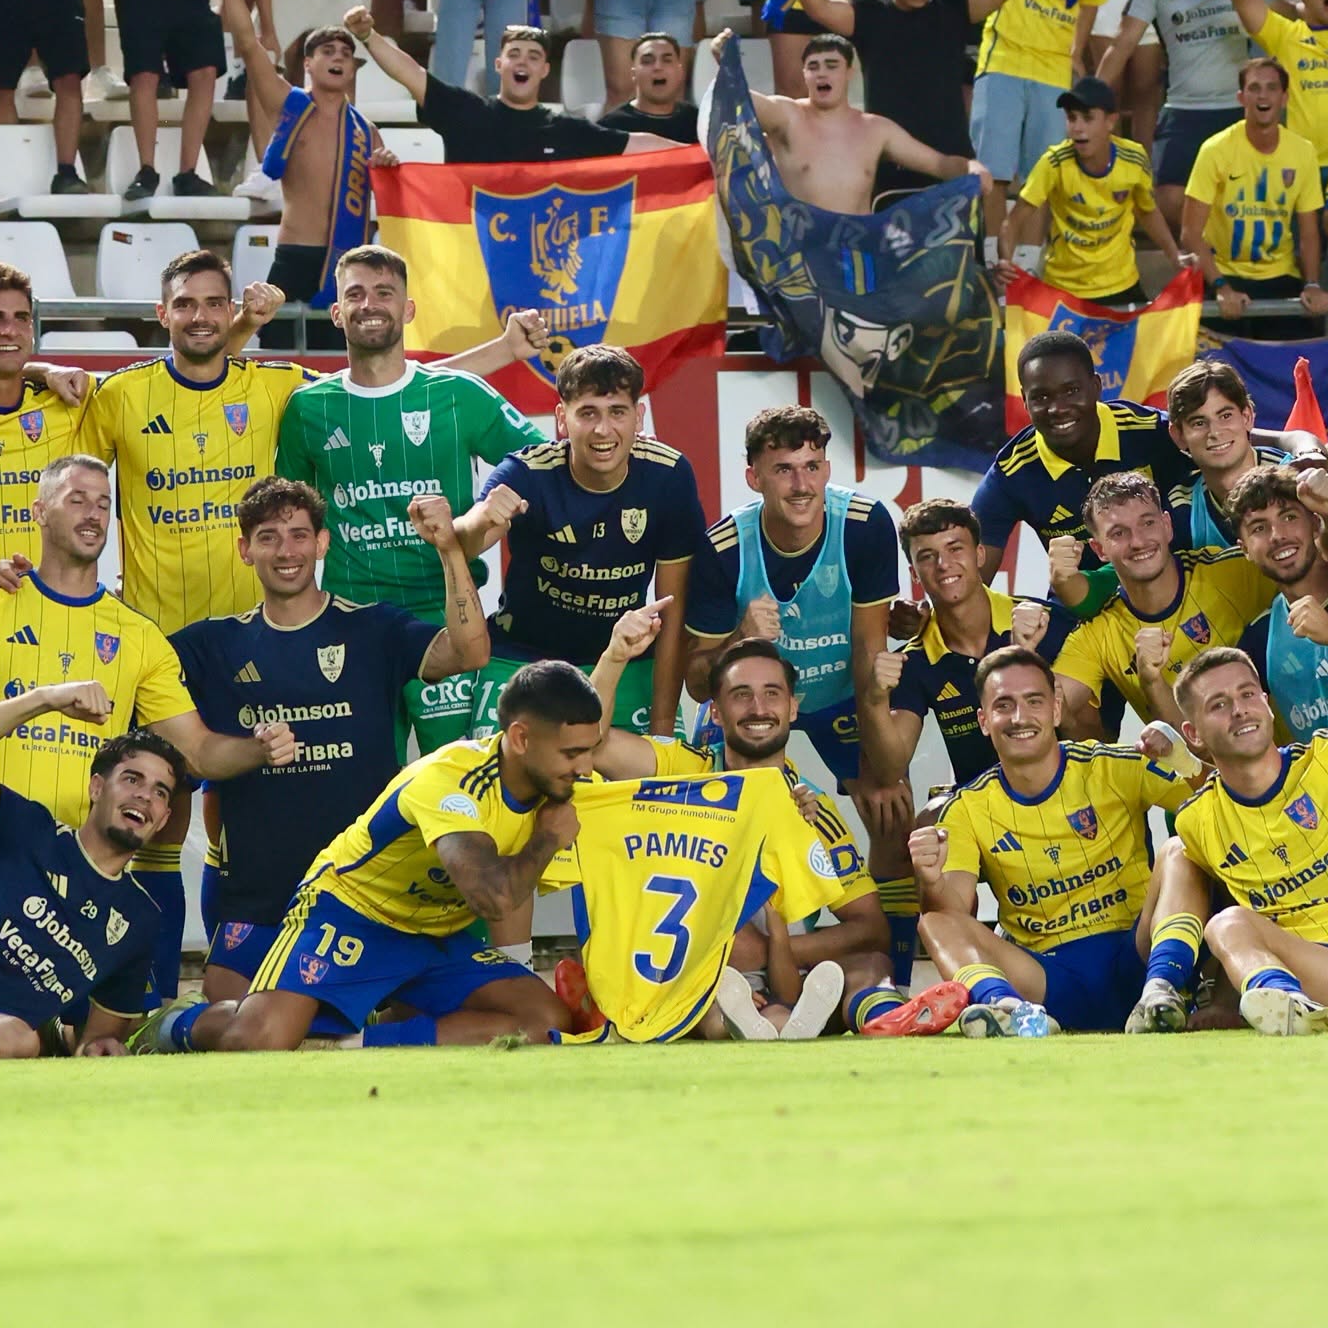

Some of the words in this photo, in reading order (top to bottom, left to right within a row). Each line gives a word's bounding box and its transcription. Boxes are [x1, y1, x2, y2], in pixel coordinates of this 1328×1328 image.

[489, 212, 517, 242] C.
[590, 206, 615, 237] F.
[166, 463, 256, 490] johnson
[347, 477, 442, 507] johnson
[16, 526, 36, 534] FIBRA
[592, 522, 605, 539] 13
[366, 542, 381, 550] REY
[404, 538, 425, 546] FIBRA
[559, 560, 646, 581] johnson
[420, 679, 472, 706] CRC
[256, 701, 353, 725] johnson
[649, 805, 678, 816] Grupo
[681, 808, 736, 823] Inmobiliario
[624, 832, 728, 868] PAMIES
[1027, 856, 1123, 906] johnson
[80, 899, 98, 919] 29
[633, 875, 699, 984] 3
[35, 910, 98, 981] johnson
[314, 922, 365, 967] 19
